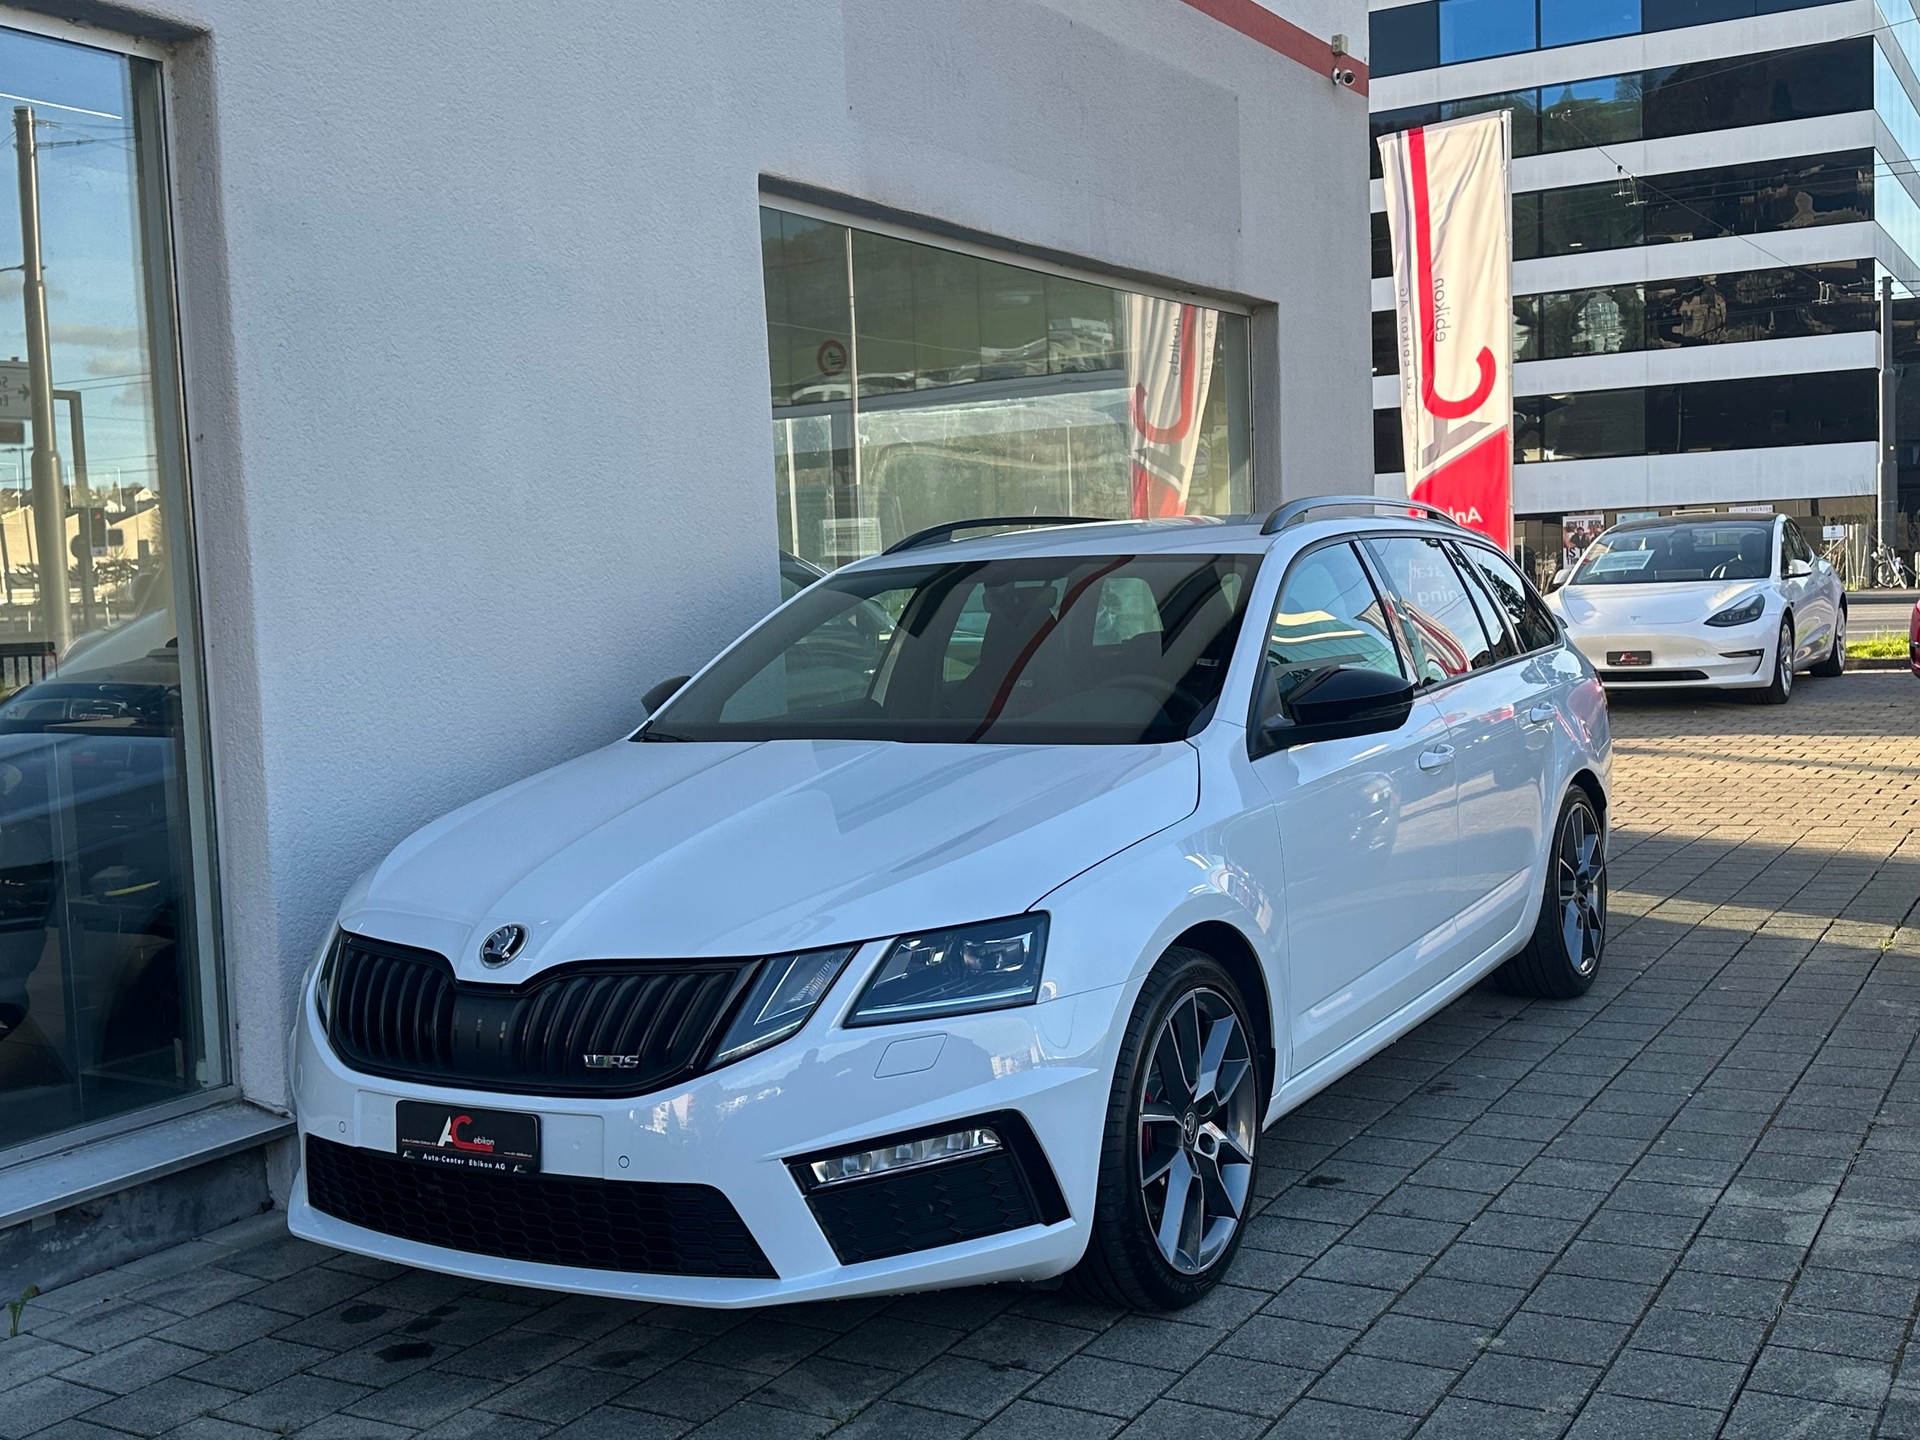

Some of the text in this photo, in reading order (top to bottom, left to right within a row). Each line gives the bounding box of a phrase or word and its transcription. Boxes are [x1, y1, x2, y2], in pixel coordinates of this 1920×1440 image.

[1168, 317, 1183, 377] ebikon
[473, 1135, 495, 1146] ebikon
[422, 1153, 506, 1171] Auto-Center Ebikon AG
